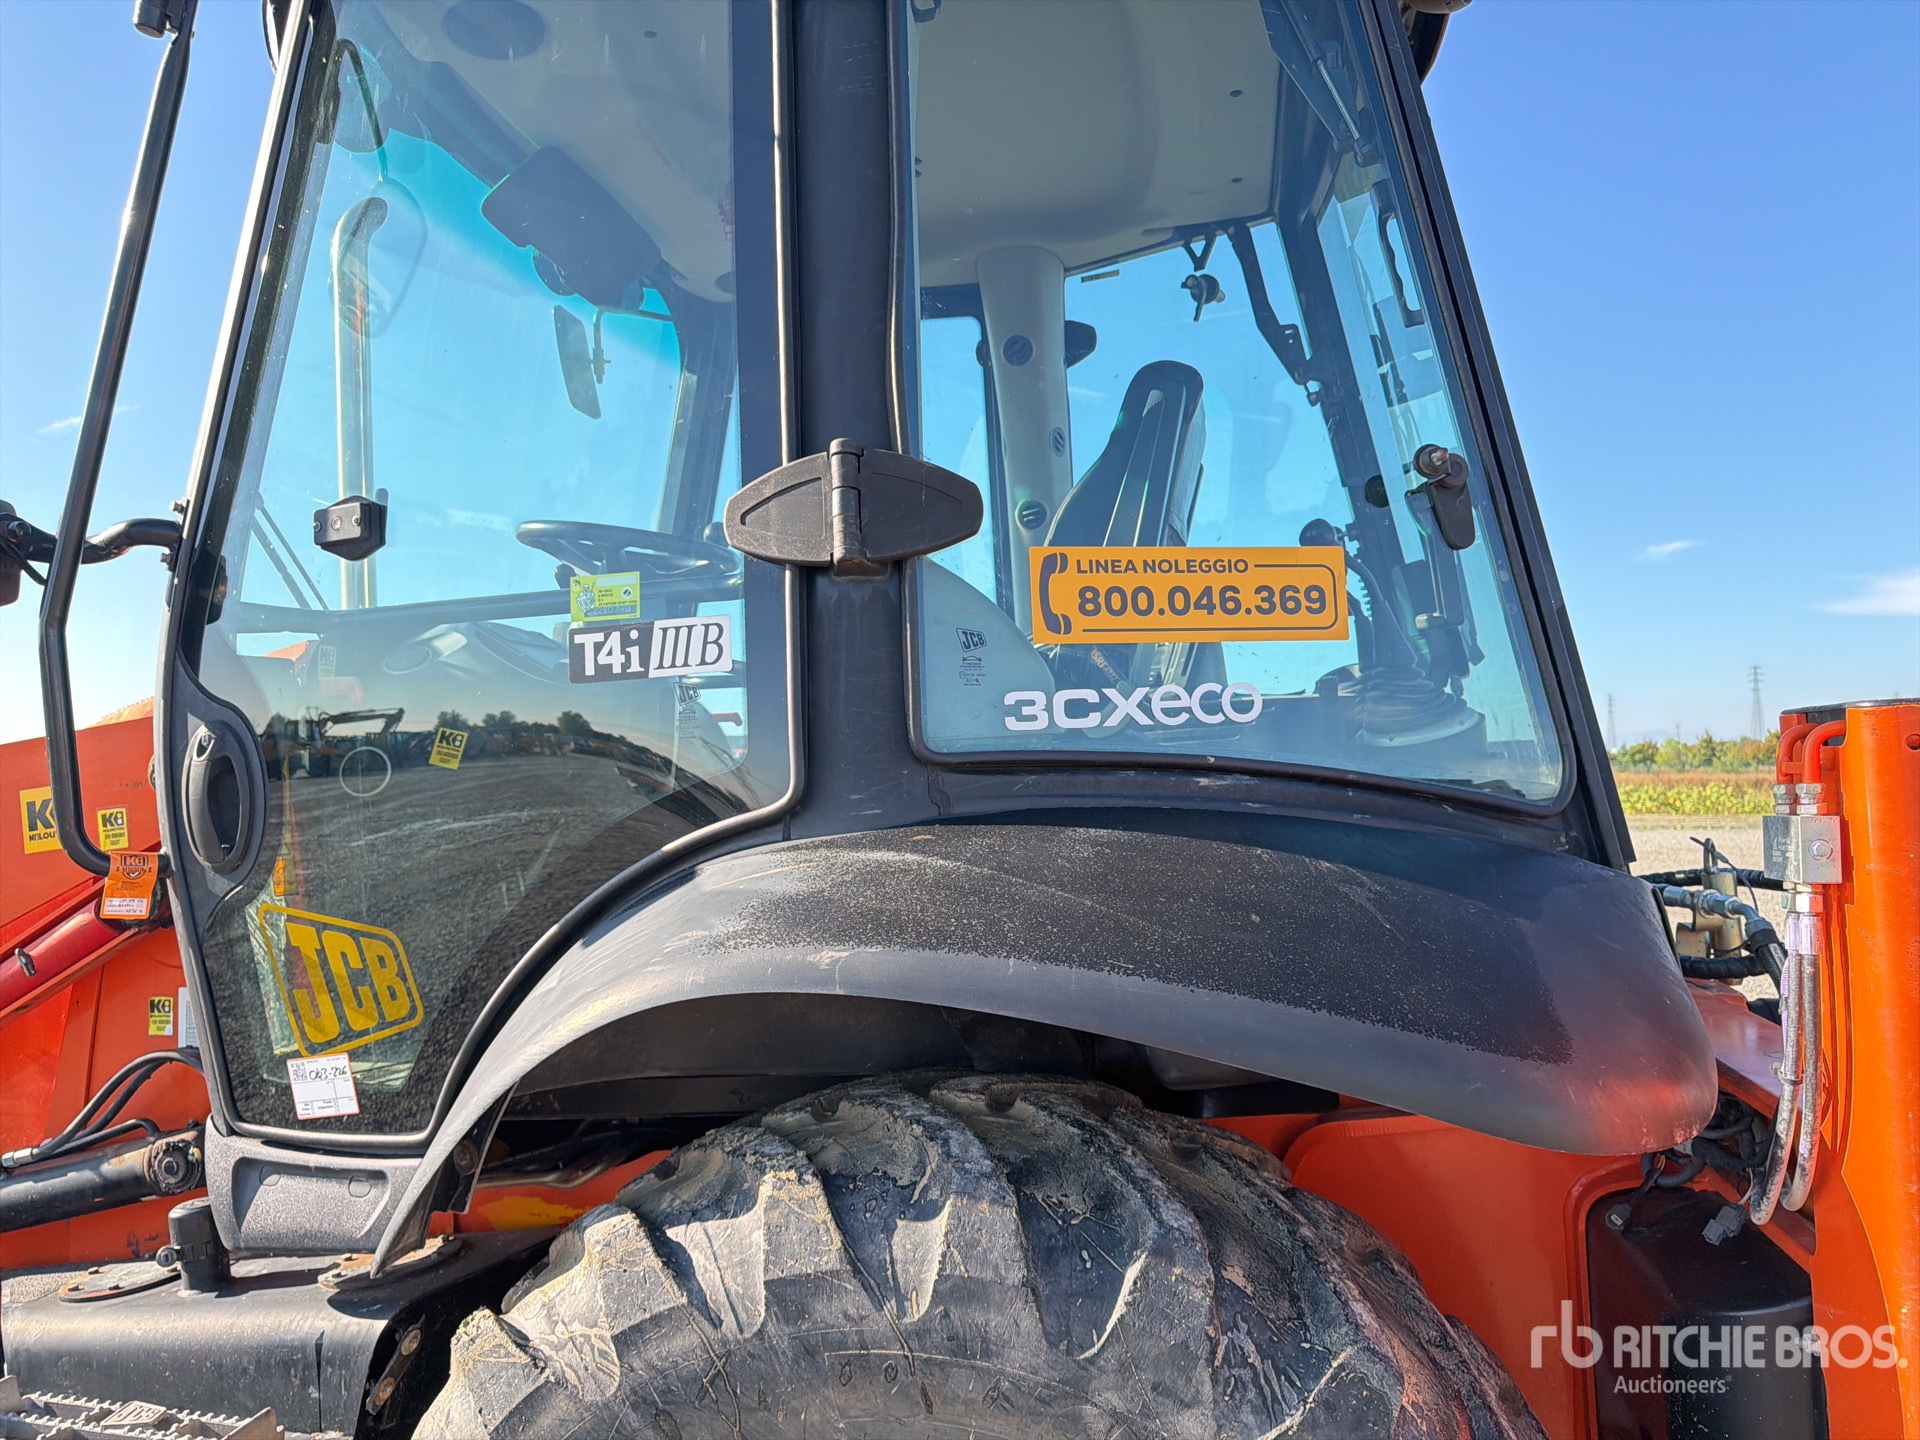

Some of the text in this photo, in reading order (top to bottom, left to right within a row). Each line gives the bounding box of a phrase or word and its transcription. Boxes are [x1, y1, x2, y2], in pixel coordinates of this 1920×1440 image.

[1076, 558, 1249, 574] LINEA NOLEGGIO
[1077, 584, 1327, 617] 800.046.369
[573, 629, 645, 677] T4i
[961, 630, 985, 650] JCB
[678, 684, 699, 704] JCB
[285, 922, 411, 1044] JCB
